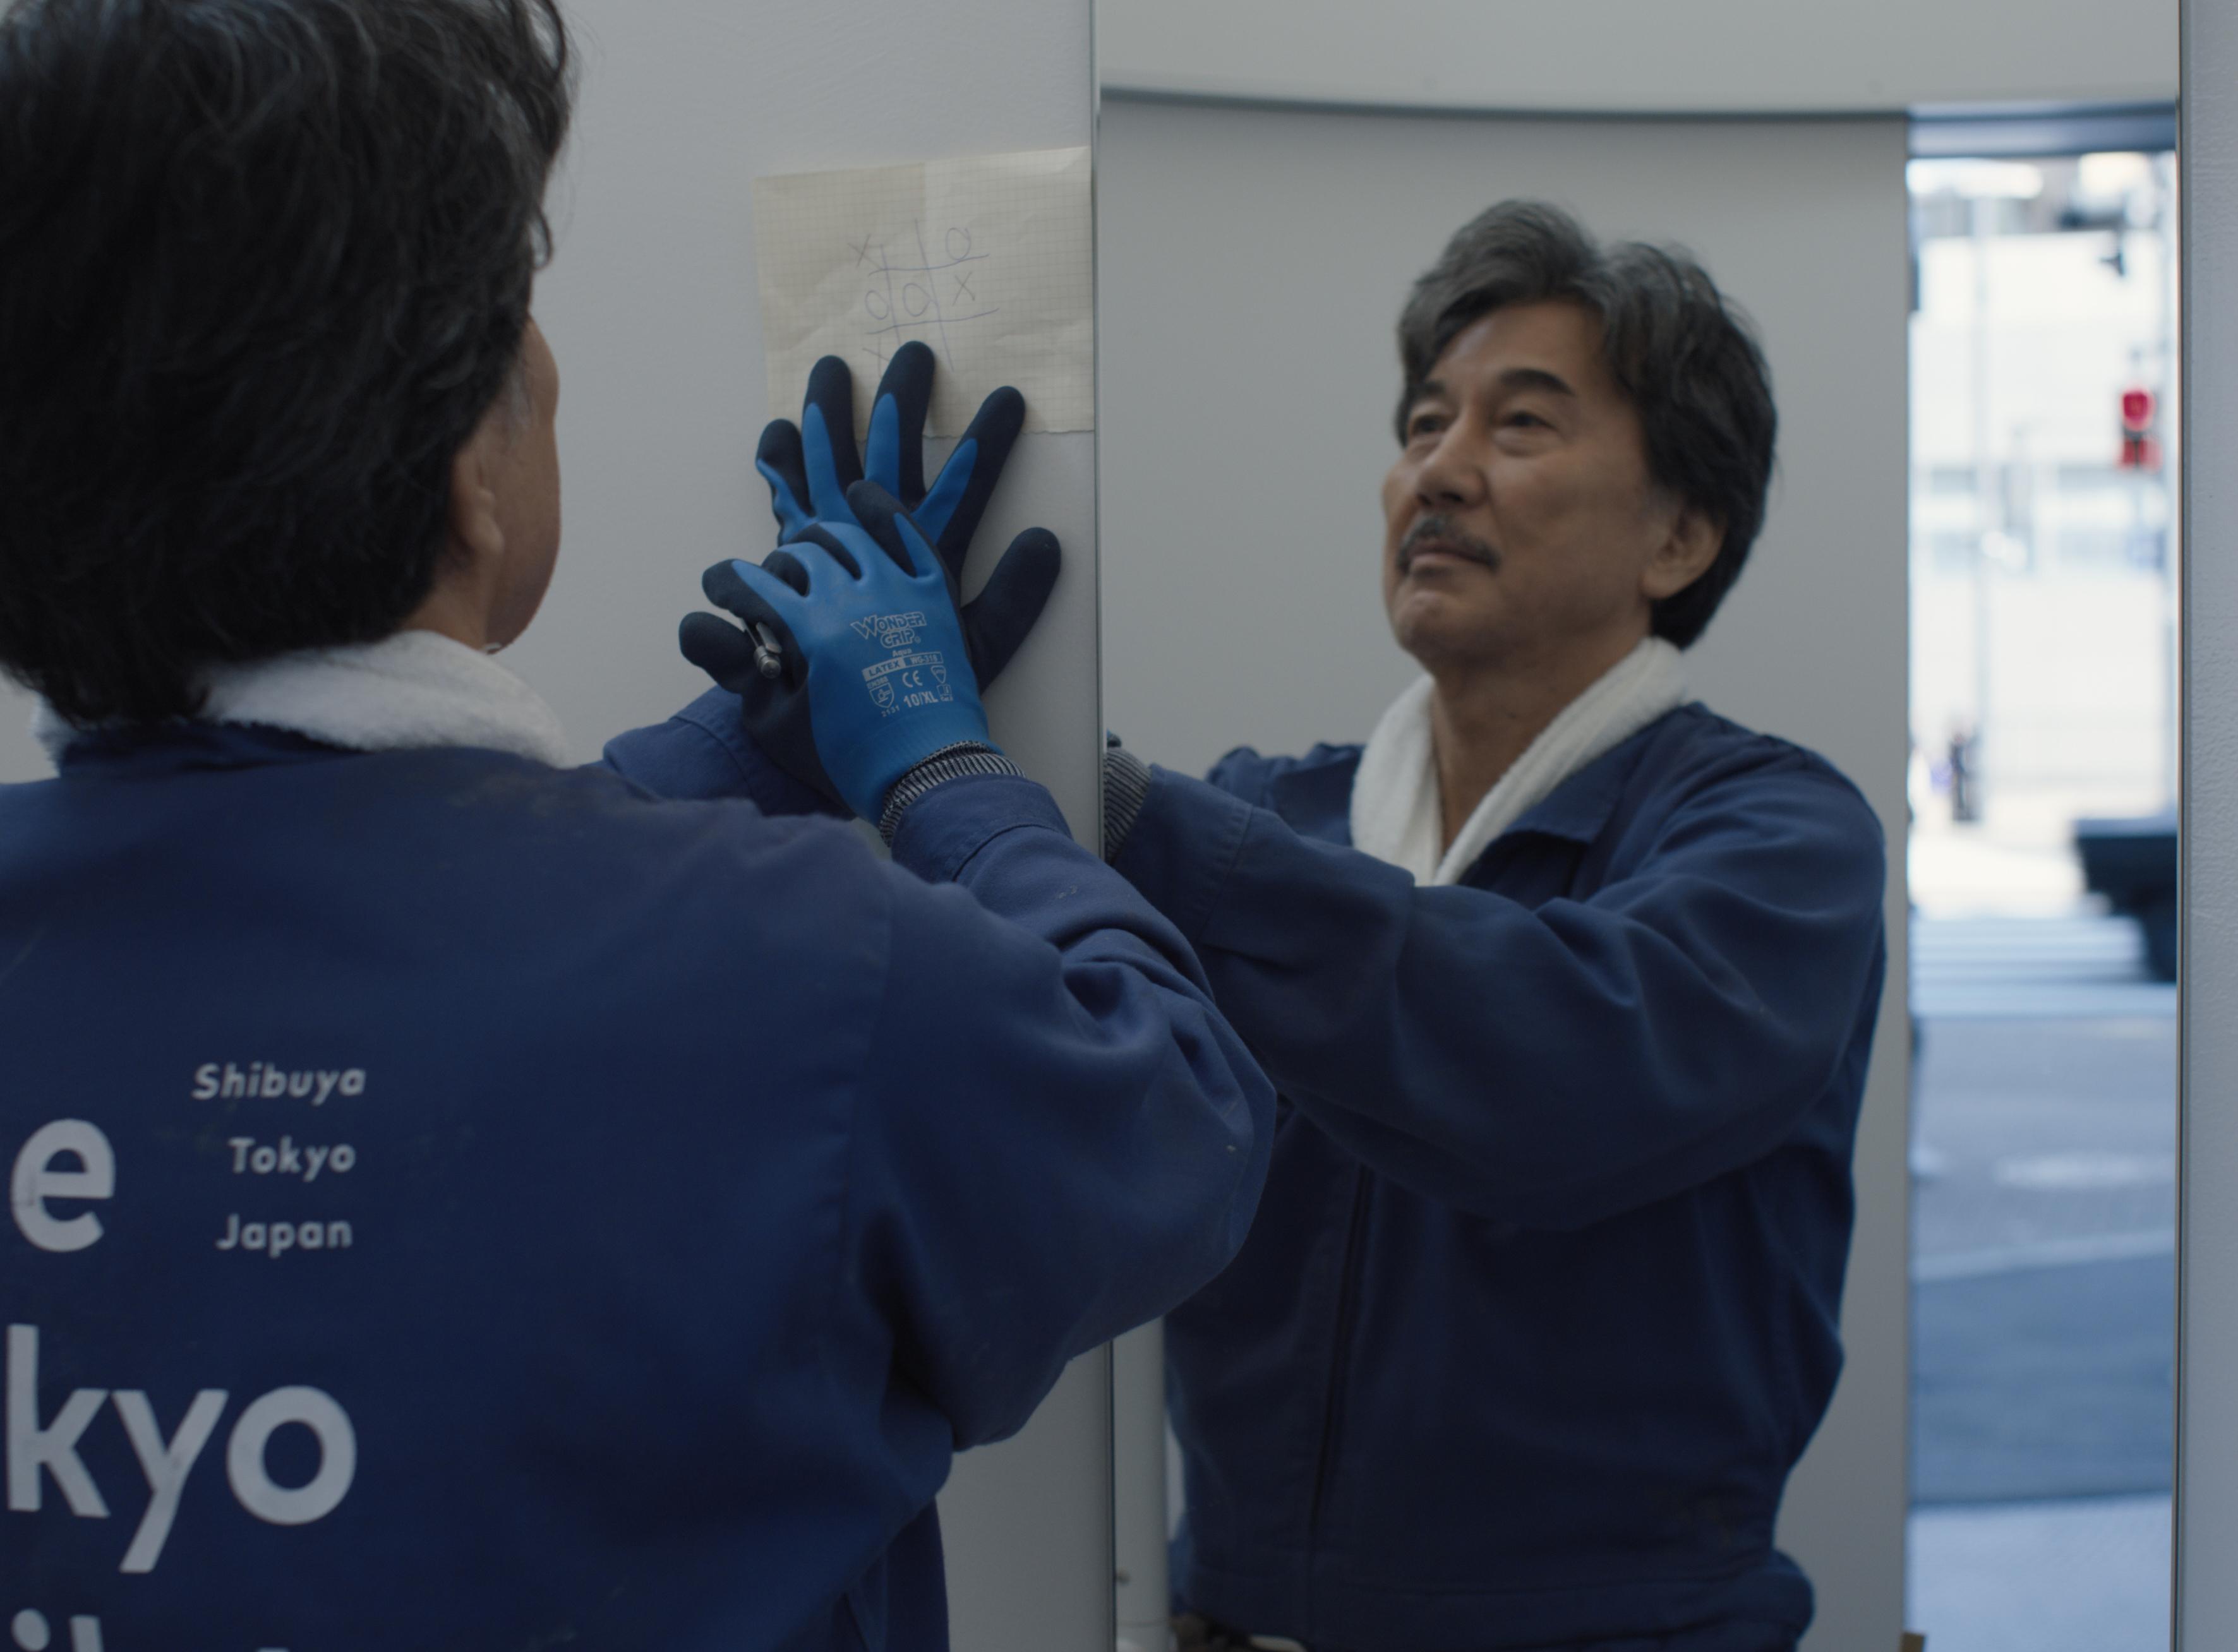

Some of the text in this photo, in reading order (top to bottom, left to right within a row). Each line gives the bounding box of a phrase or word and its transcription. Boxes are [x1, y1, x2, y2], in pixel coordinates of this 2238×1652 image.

[850, 611, 927, 640] WONDER
[881, 628, 915, 648] GRIP
[869, 659, 900, 676] LATEX
[903, 691, 939, 708] 10/XL
[193, 1063, 365, 1104] Shibuya
[229, 1137, 356, 1181] Tokyo
[217, 1215, 352, 1257] Japan
